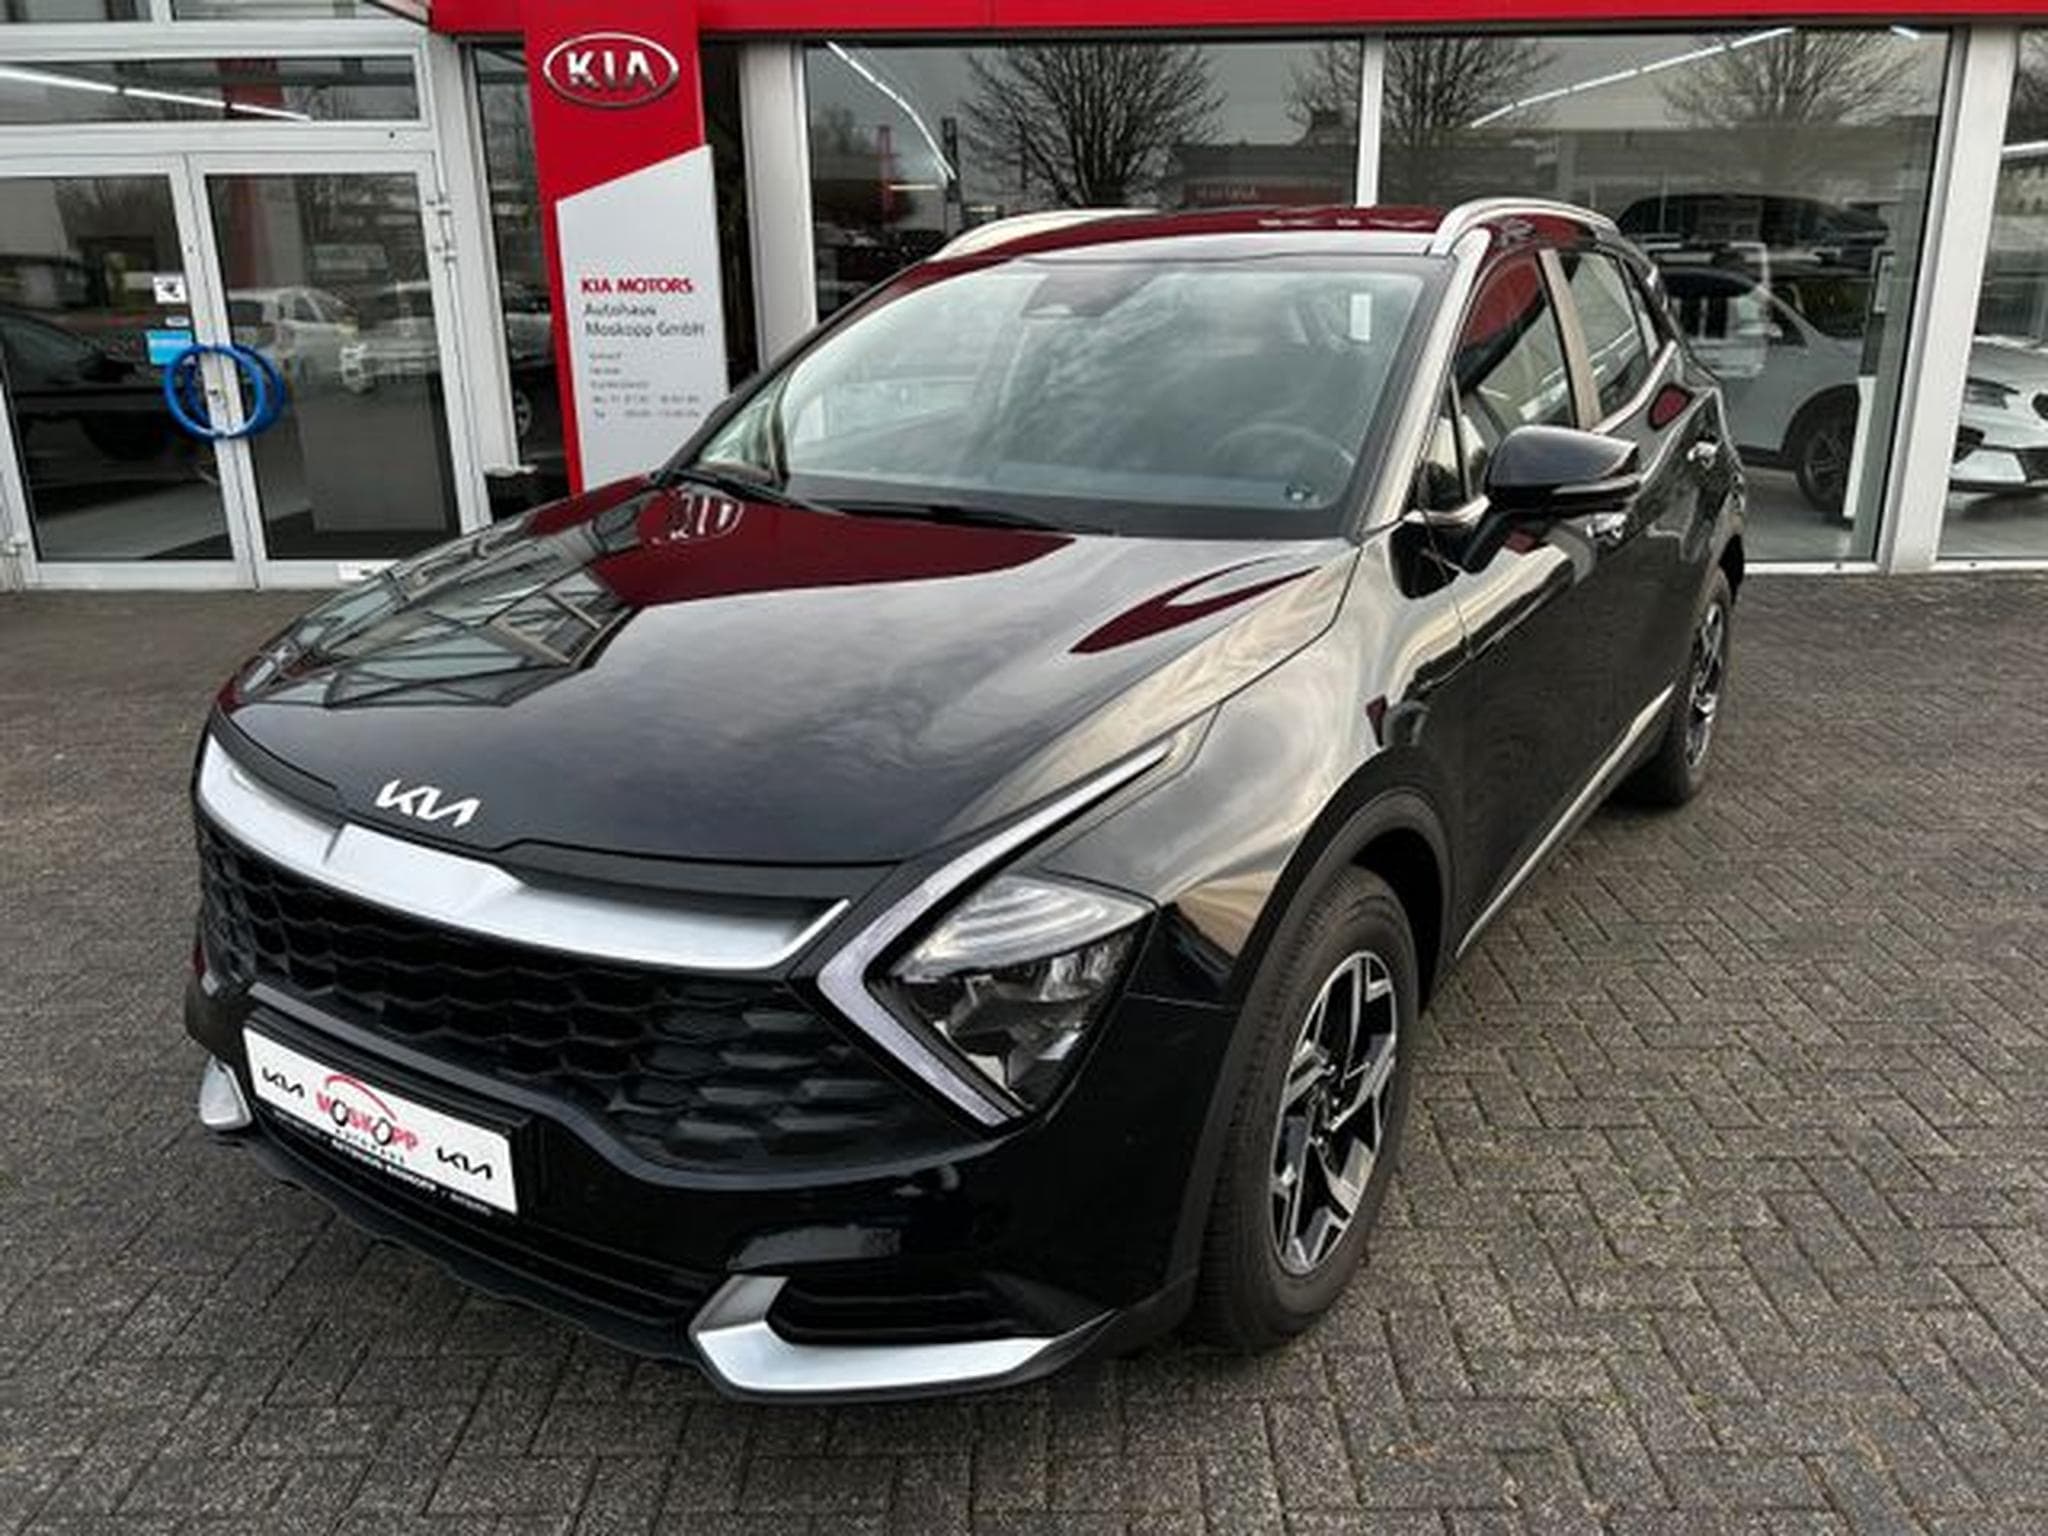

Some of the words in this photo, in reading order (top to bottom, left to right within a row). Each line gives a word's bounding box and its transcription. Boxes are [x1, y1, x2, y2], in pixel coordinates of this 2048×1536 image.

[566, 50, 658, 90] KIA
[580, 277, 612, 294] KIA
[617, 276, 694, 295] MOTORS
[584, 303, 656, 317] Autohaus
[656, 320, 705, 337] GmbH
[375, 779, 480, 828] KIA
[261, 1066, 305, 1098] KIA
[436, 1146, 493, 1180] KIA
